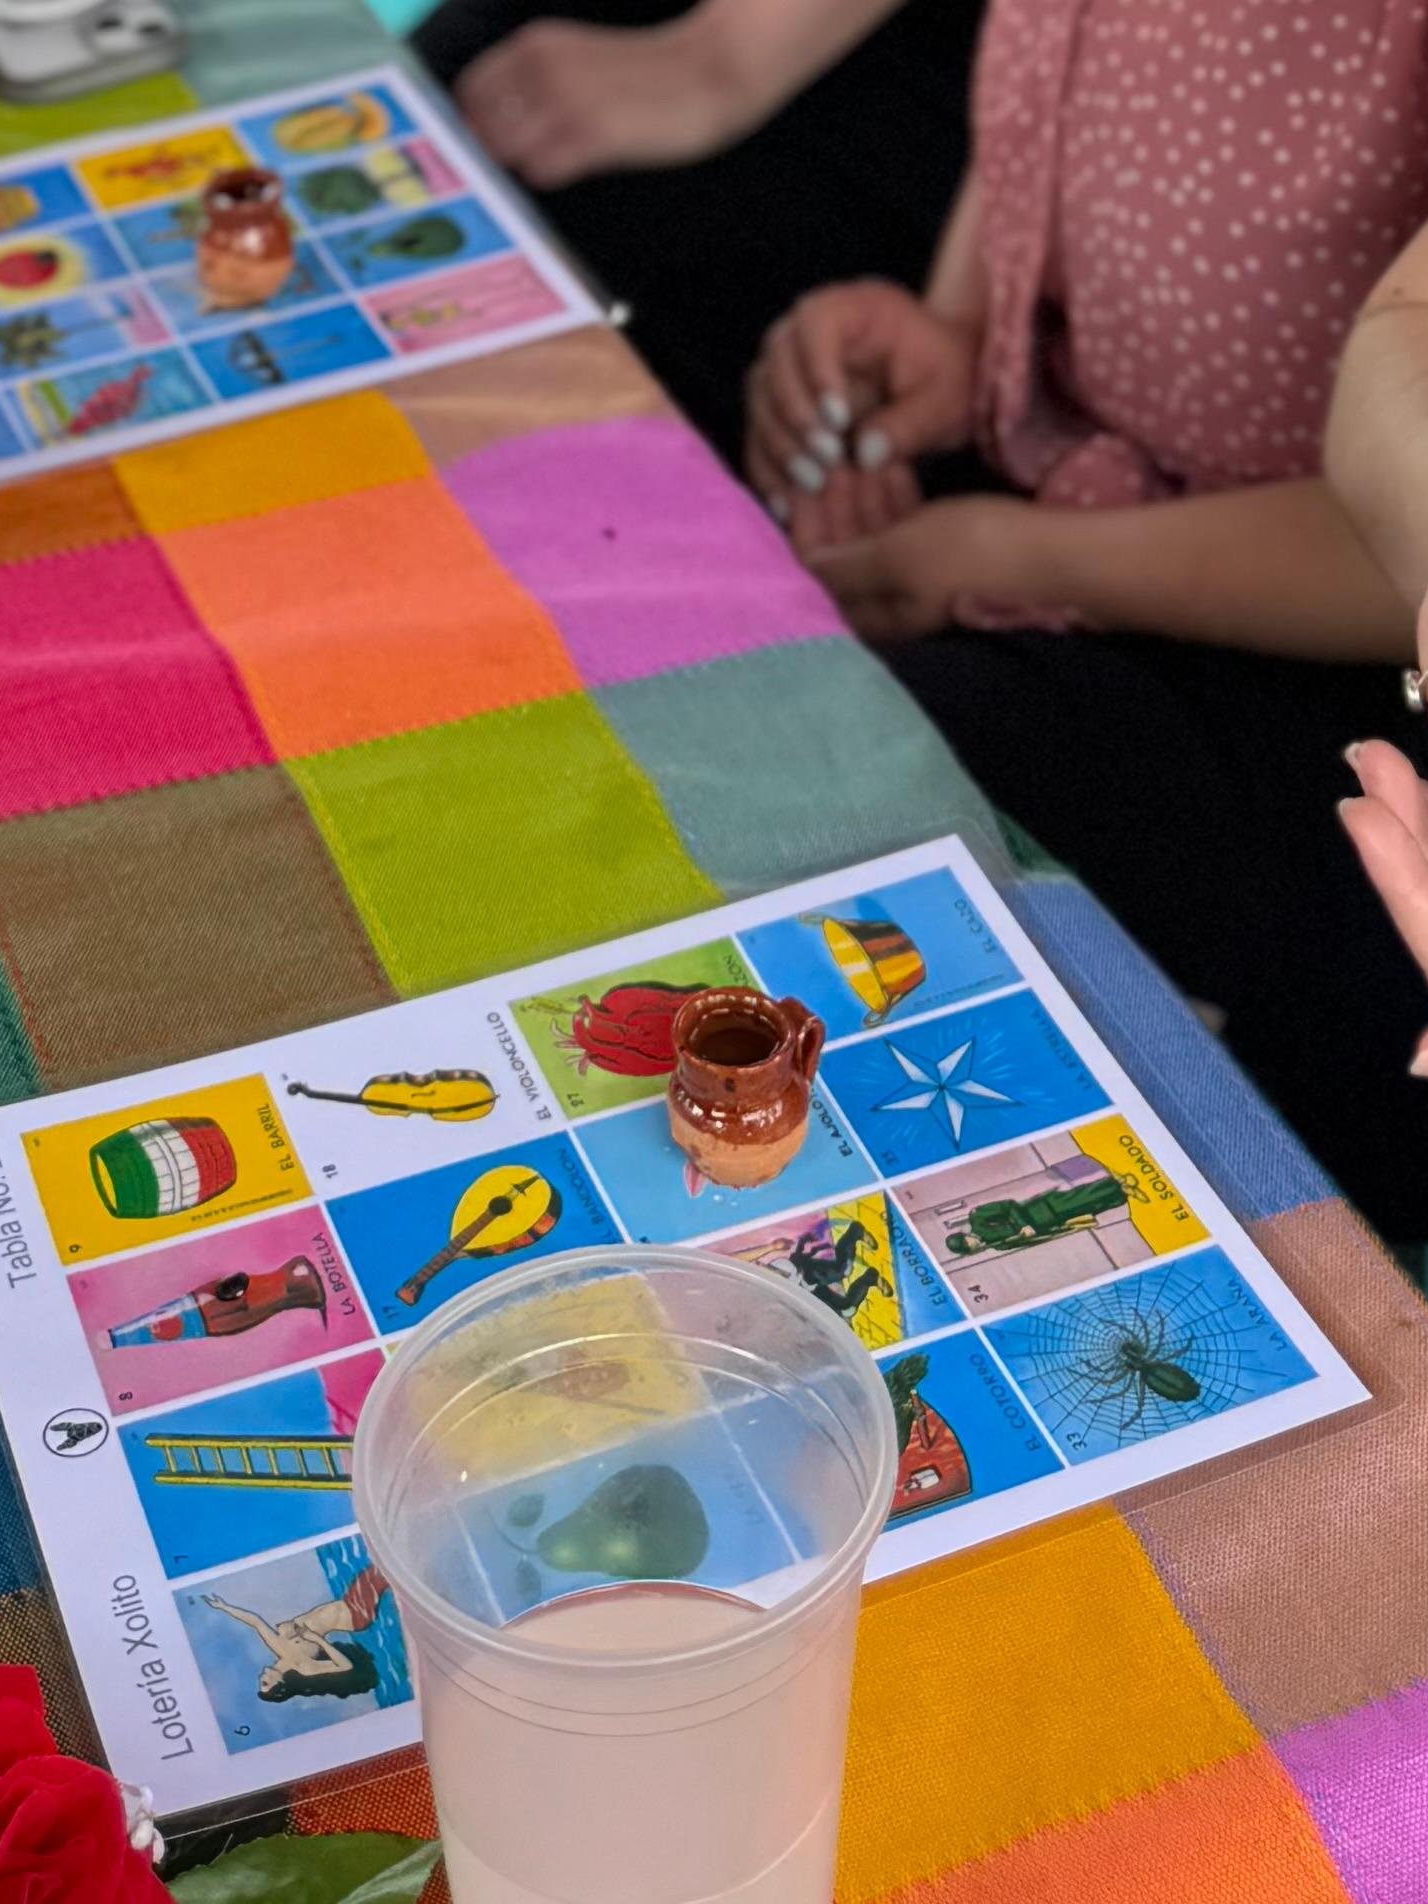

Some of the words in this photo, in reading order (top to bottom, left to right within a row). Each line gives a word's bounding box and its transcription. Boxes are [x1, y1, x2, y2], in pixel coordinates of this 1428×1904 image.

[954, 898, 982, 935] CAZO
[983, 937, 997, 954] EL
[487, 1011, 539, 1102] VIOLONCELLO
[566, 1092, 585, 1109] 27
[536, 1105, 552, 1121] EL
[256, 1102, 285, 1149] BARRIL
[837, 1139, 854, 1157] EL
[278, 1154, 294, 1172] EL
[321, 1164, 339, 1180] 18
[1118, 1134, 1174, 1202] SOLDADO
[1170, 1203, 1190, 1223] EL
[68, 1243, 83, 1254] 9
[311, 1231, 346, 1294] BOTELLA
[927, 1289, 948, 1307] EL
[967, 1284, 989, 1304] 34
[339, 1297, 356, 1316] LA
[381, 1304, 400, 1320] 17
[1270, 1331, 1289, 1352] LA
[118, 1391, 134, 1402] 8
[968, 1353, 1027, 1431] COTORRO
[1024, 1433, 1042, 1452] EL
[1066, 1430, 1089, 1451] 33
[173, 1554, 189, 1564] 7
[111, 1574, 159, 1656] Xolito
[136, 1657, 194, 1760] Lotería
[234, 1724, 251, 1737] 6
